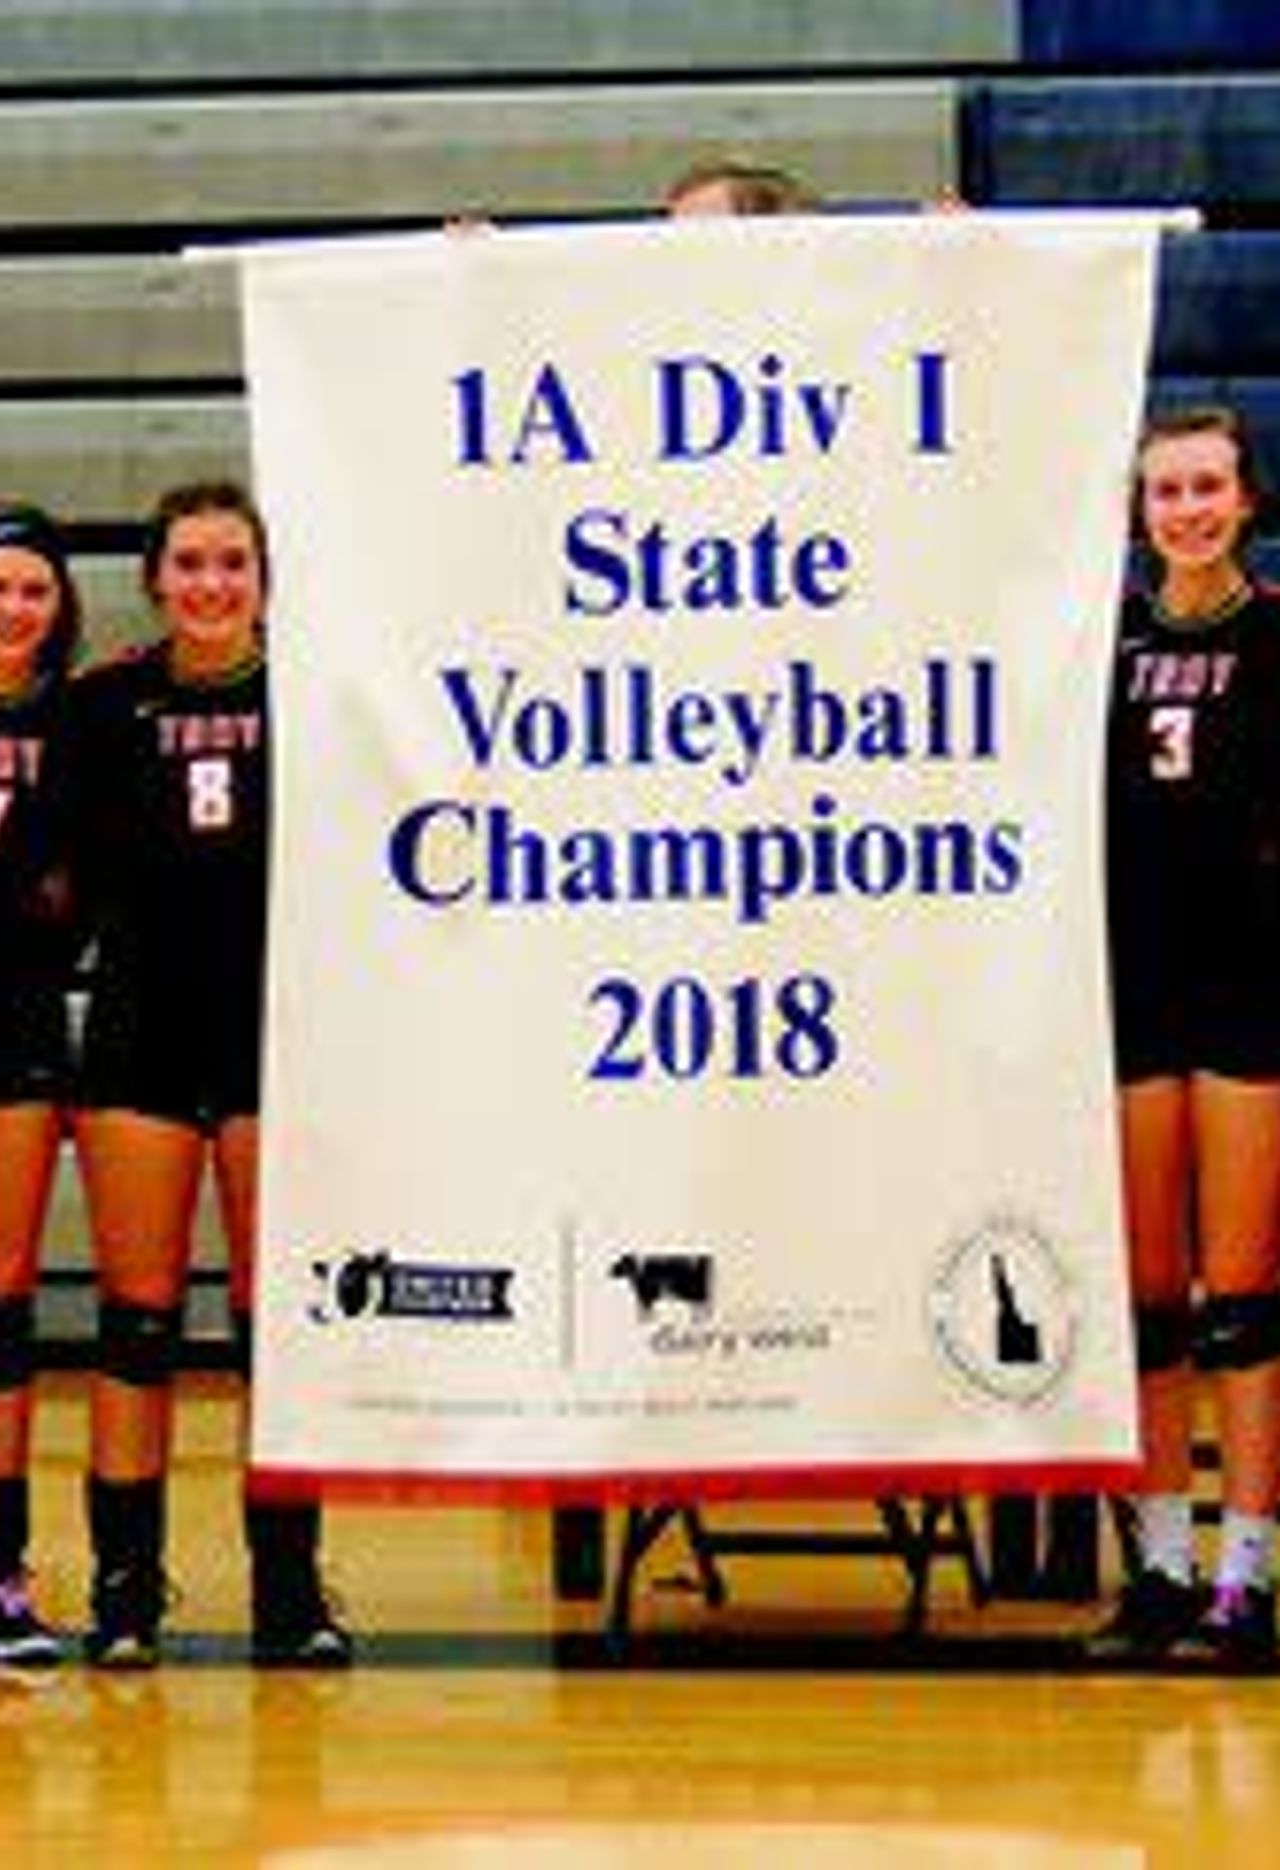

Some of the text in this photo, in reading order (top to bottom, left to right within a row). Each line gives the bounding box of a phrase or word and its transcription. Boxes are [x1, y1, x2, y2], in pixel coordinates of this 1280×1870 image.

[450, 351, 954, 466] 1A Div I
[564, 508, 851, 616] State
[439, 658, 999, 787] Volleyball
[1128, 654, 1236, 700] TROY
[157, 711, 261, 755] TROY
[1150, 708, 1193, 780] 3
[187, 759, 232, 831] 8
[387, 793, 1024, 923] Champions
[587, 976, 839, 1081] 2018
